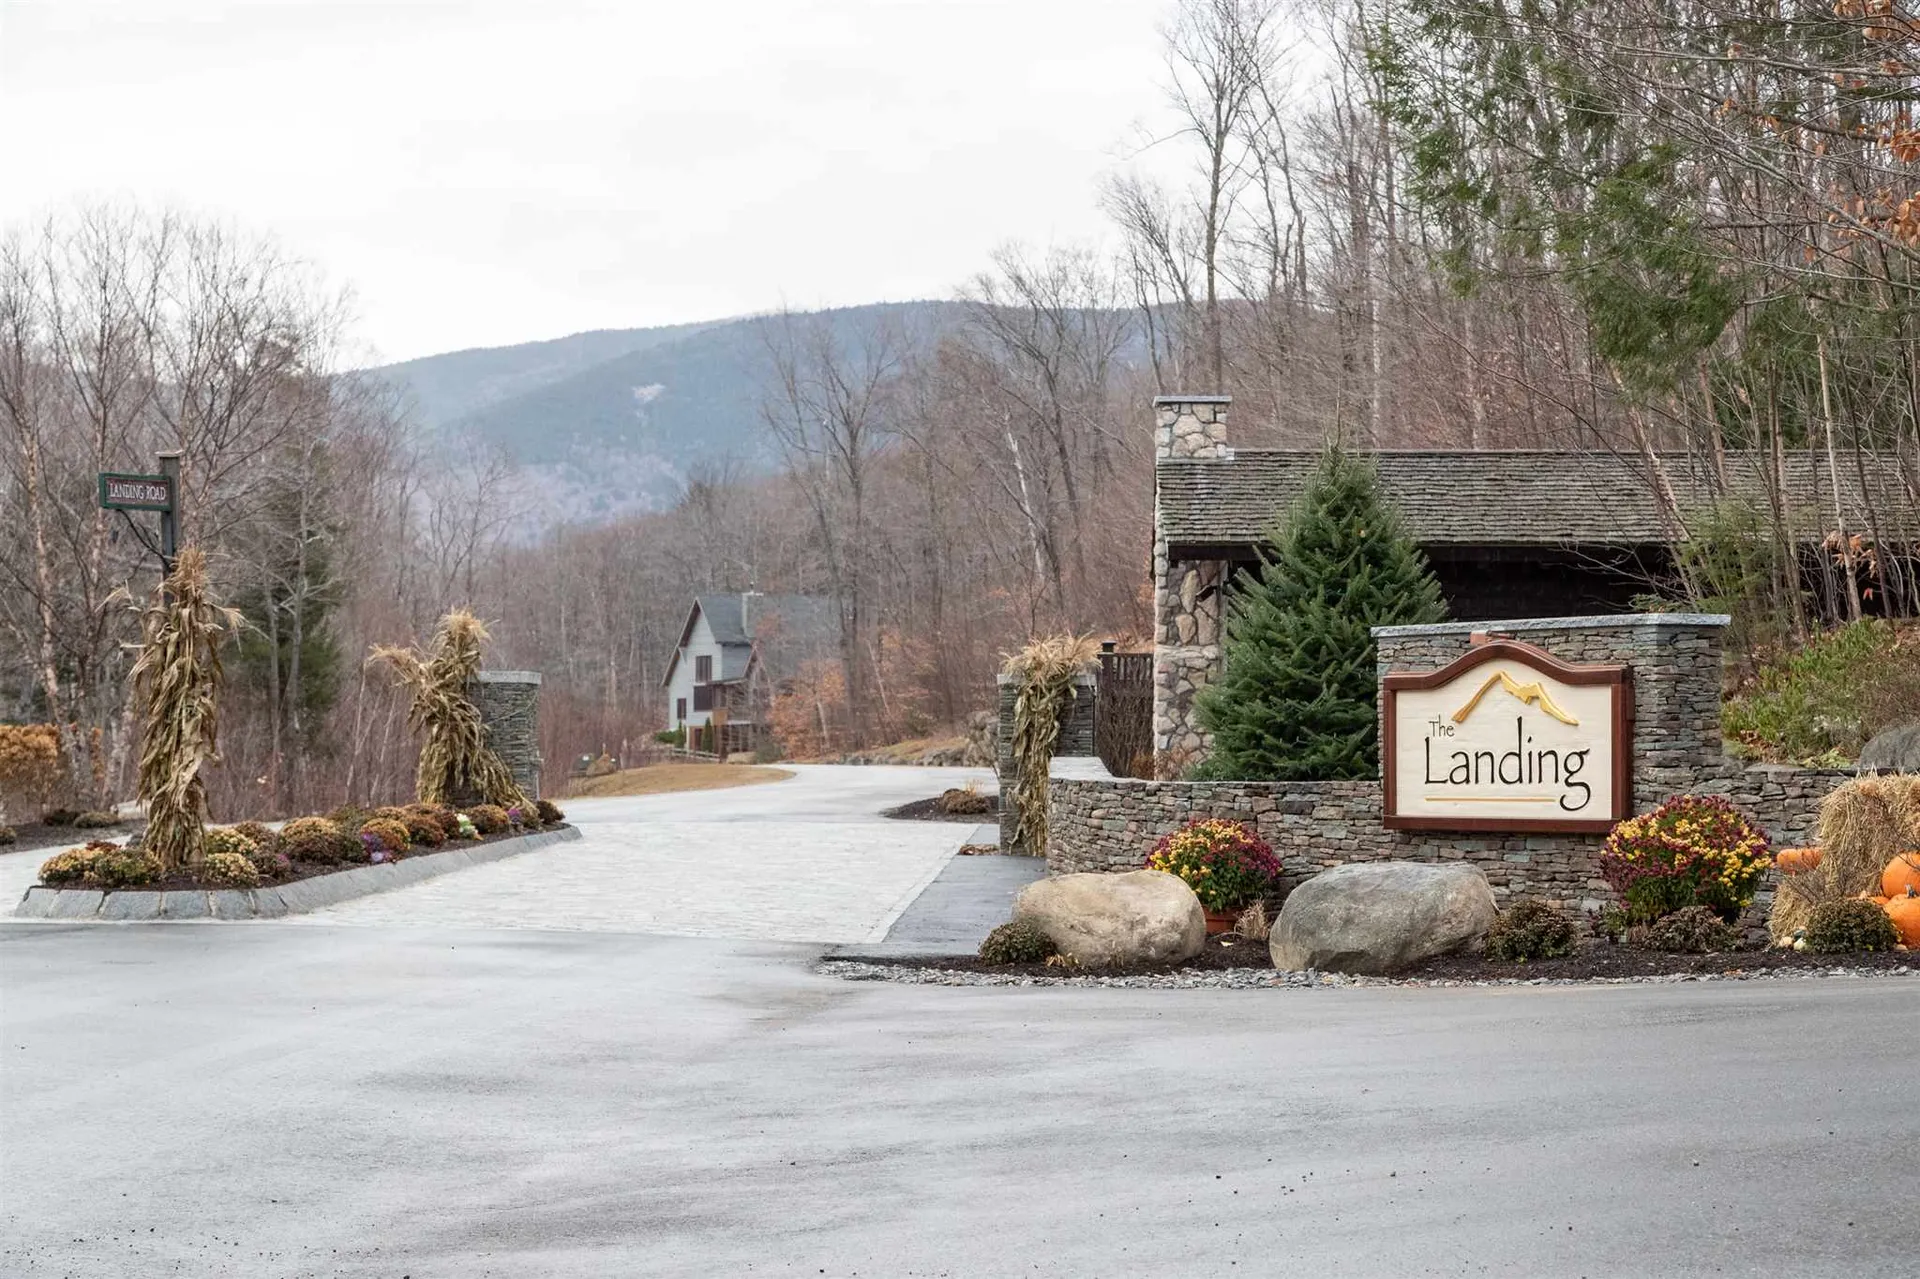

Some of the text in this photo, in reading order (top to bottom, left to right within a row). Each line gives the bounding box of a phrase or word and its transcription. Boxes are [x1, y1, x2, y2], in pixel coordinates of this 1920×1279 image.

[109, 483, 166, 501] LANDING ROAD
[1428, 714, 1455, 738] The
[1424, 716, 1591, 812] Landing
